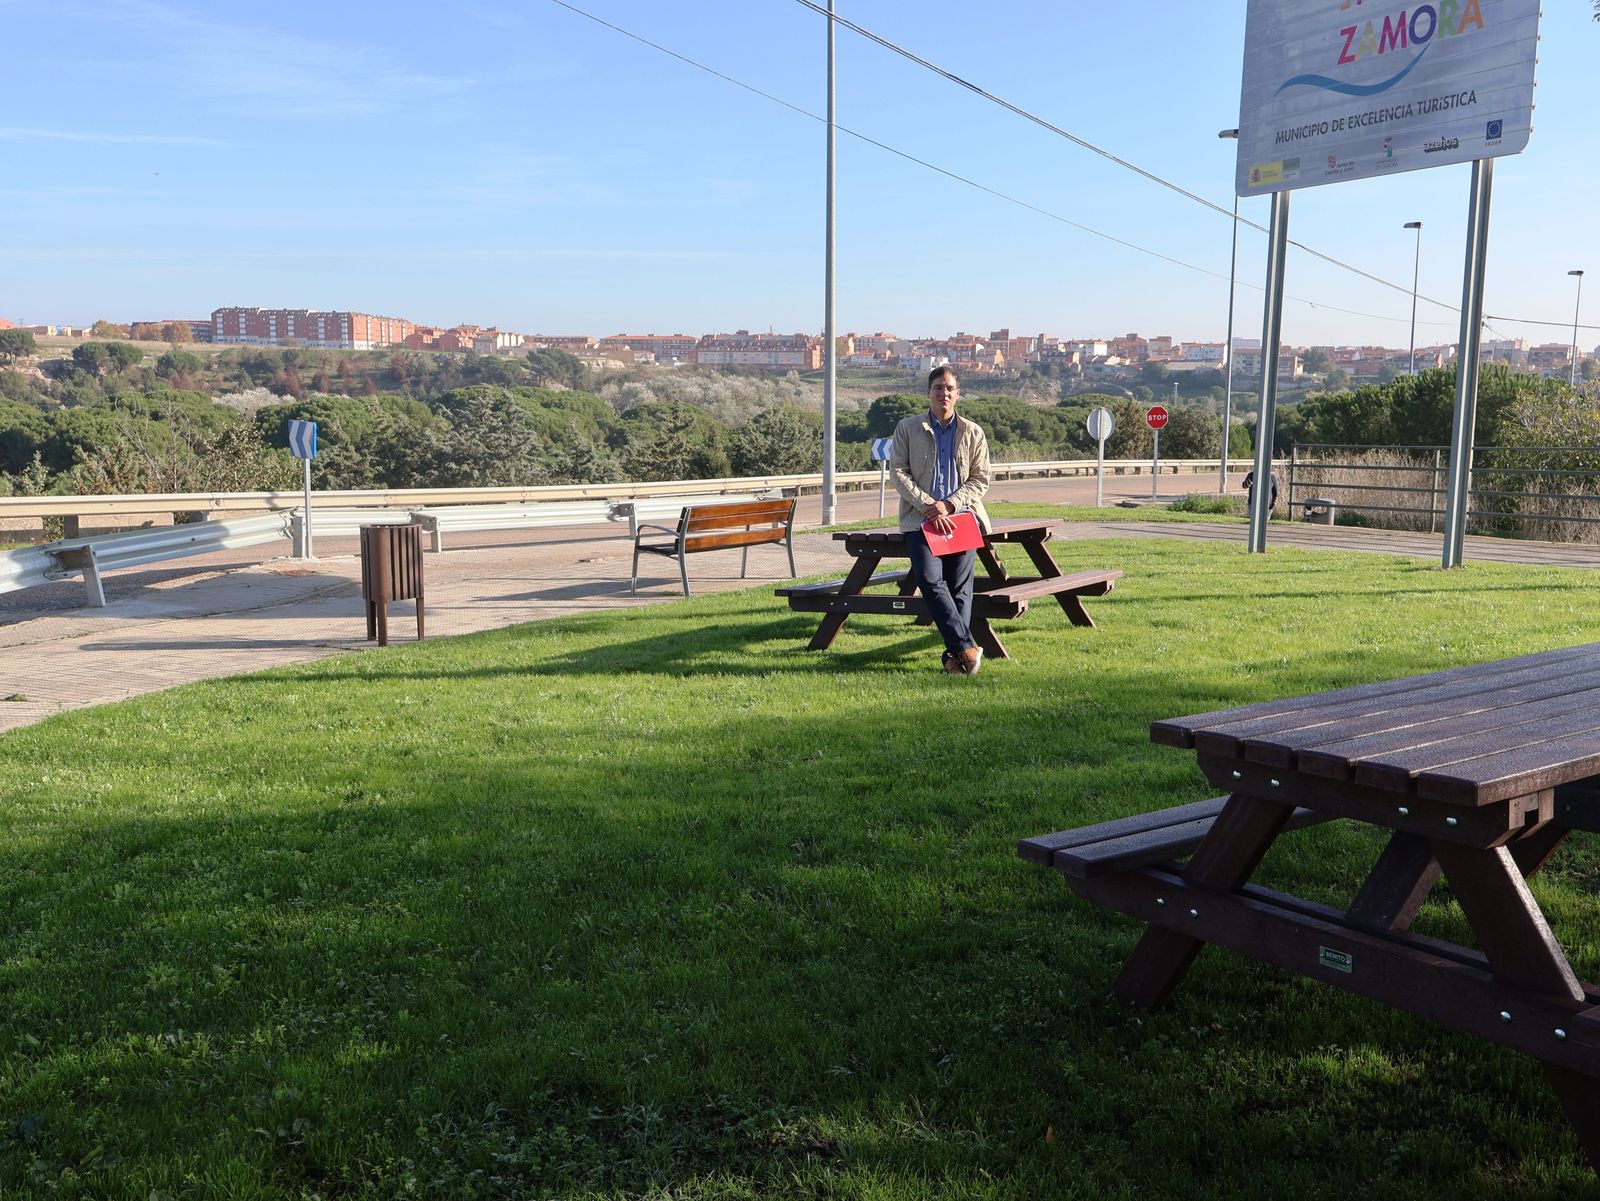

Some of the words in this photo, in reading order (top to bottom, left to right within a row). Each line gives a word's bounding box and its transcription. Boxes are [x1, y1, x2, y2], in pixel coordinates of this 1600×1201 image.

[1337, 0, 1484, 65] ZAMORA
[1275, 121, 1328, 144] MUNICIPIO
[1331, 118, 1345, 132] DE
[1348, 103, 1413, 129] EXCELENCIA
[1325, 951, 1345, 962] BENITO
